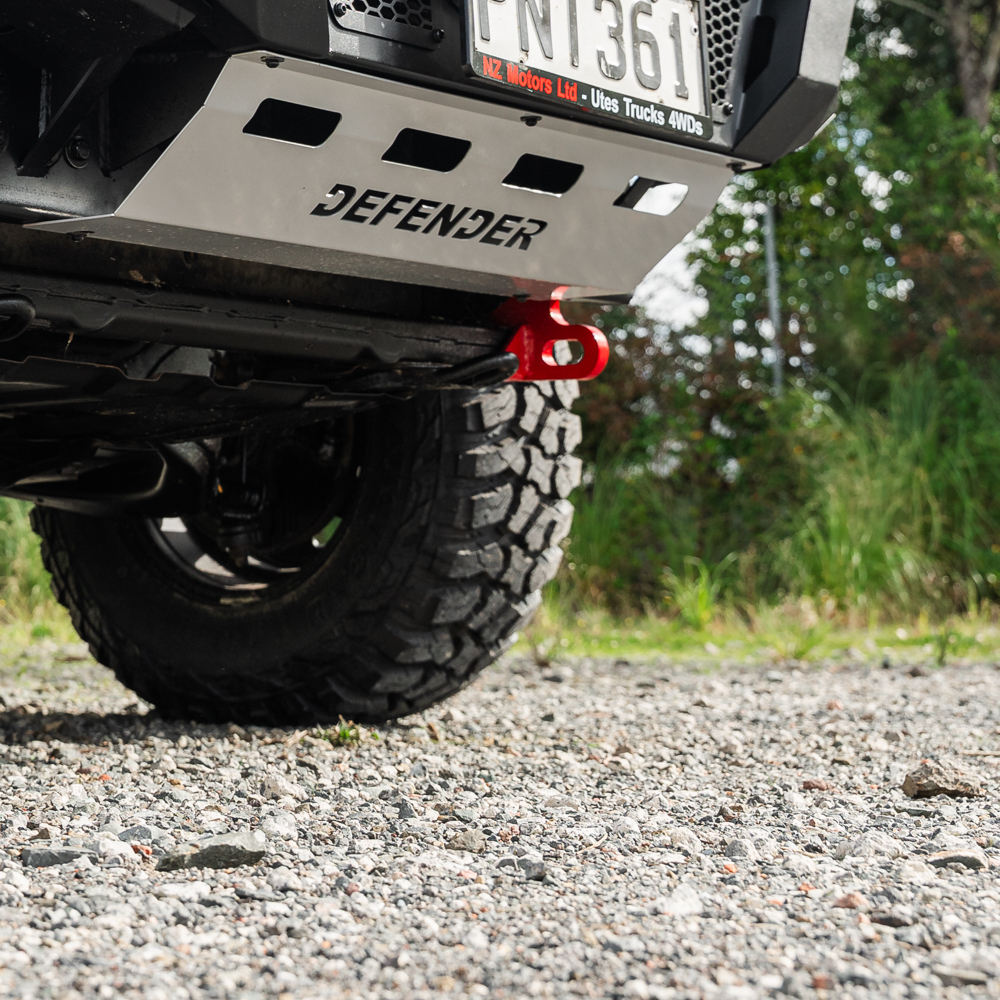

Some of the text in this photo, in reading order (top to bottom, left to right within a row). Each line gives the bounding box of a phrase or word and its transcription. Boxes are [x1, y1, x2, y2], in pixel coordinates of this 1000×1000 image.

[482, 55, 503, 80] NZ
[506, 62, 552, 95] Motors
[556, 77, 578, 102] Ltd
[590, 87, 620, 114] Utes
[622, 96, 665, 126] Trucks
[668, 109, 704, 136] 4WDs
[309, 183, 548, 251] DEFENDER
